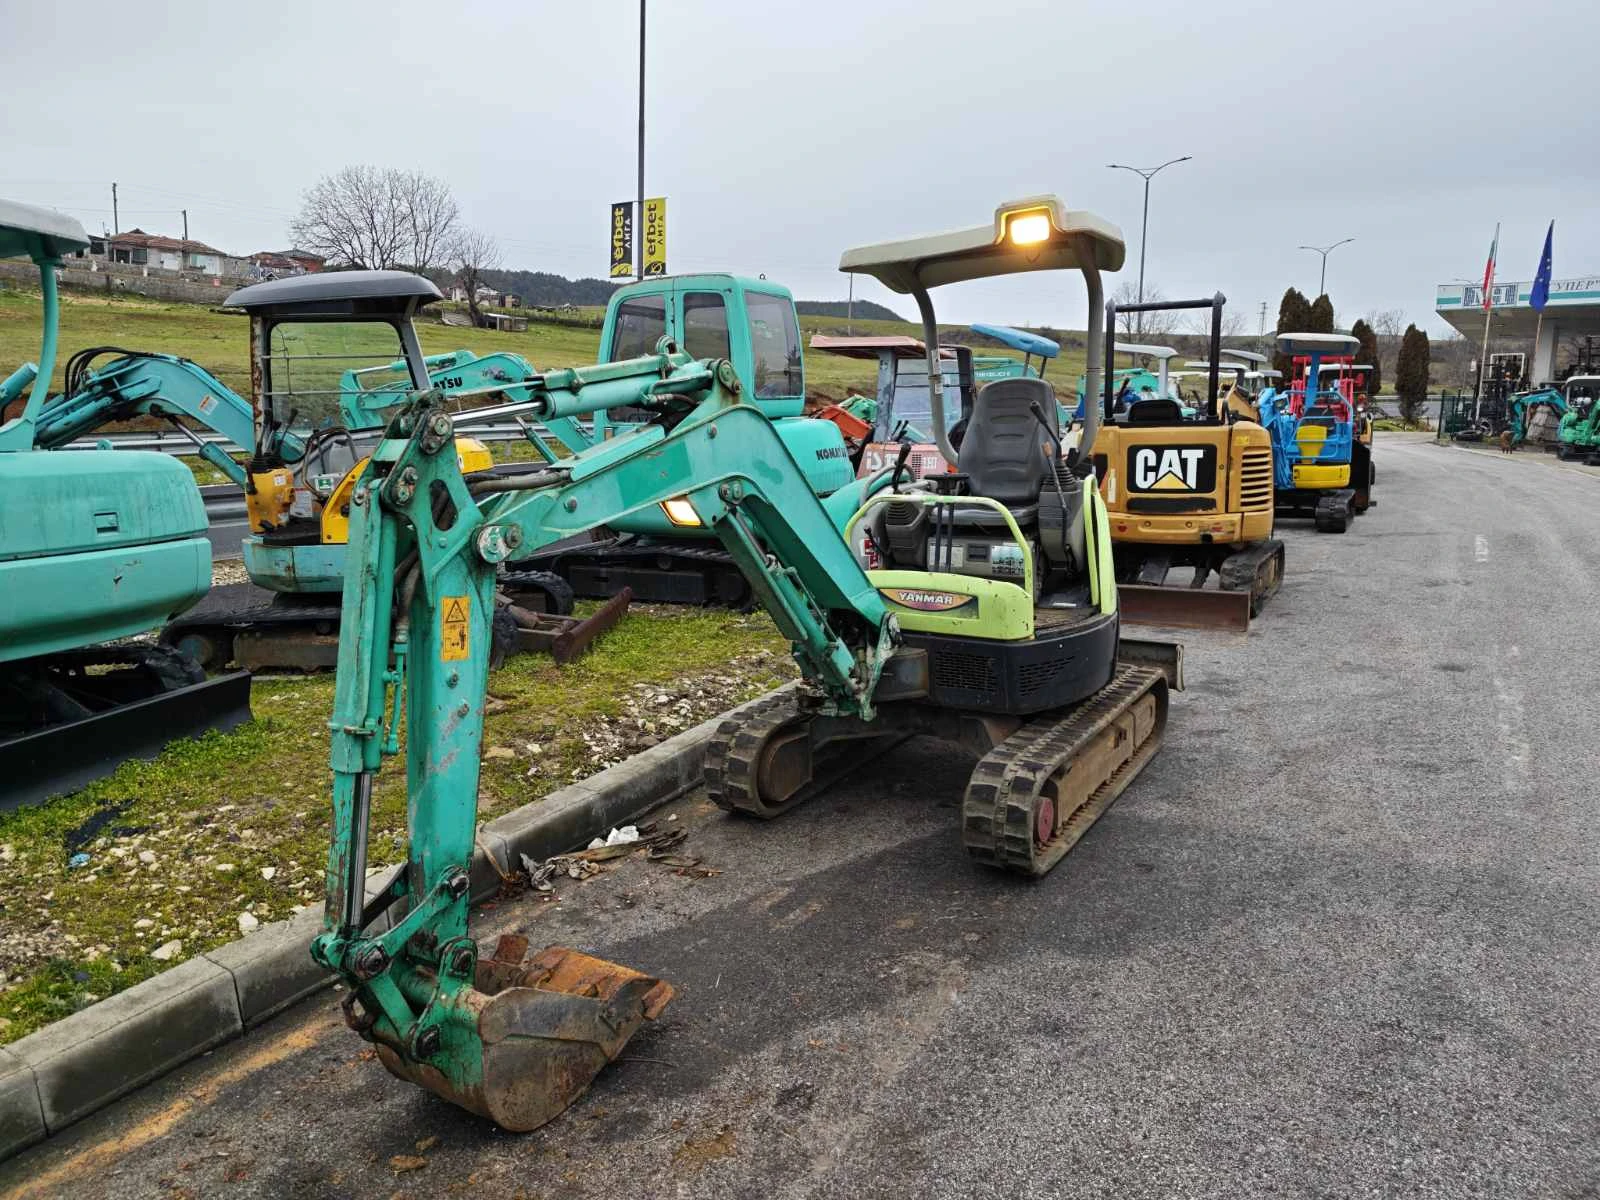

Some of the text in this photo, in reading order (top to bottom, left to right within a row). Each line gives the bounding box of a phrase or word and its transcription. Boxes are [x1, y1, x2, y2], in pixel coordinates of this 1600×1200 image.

[614, 207, 624, 260] efbet
[647, 203, 657, 256] efbet
[1135, 448, 1204, 490] CAT
[898, 592, 953, 605] YANMAR
